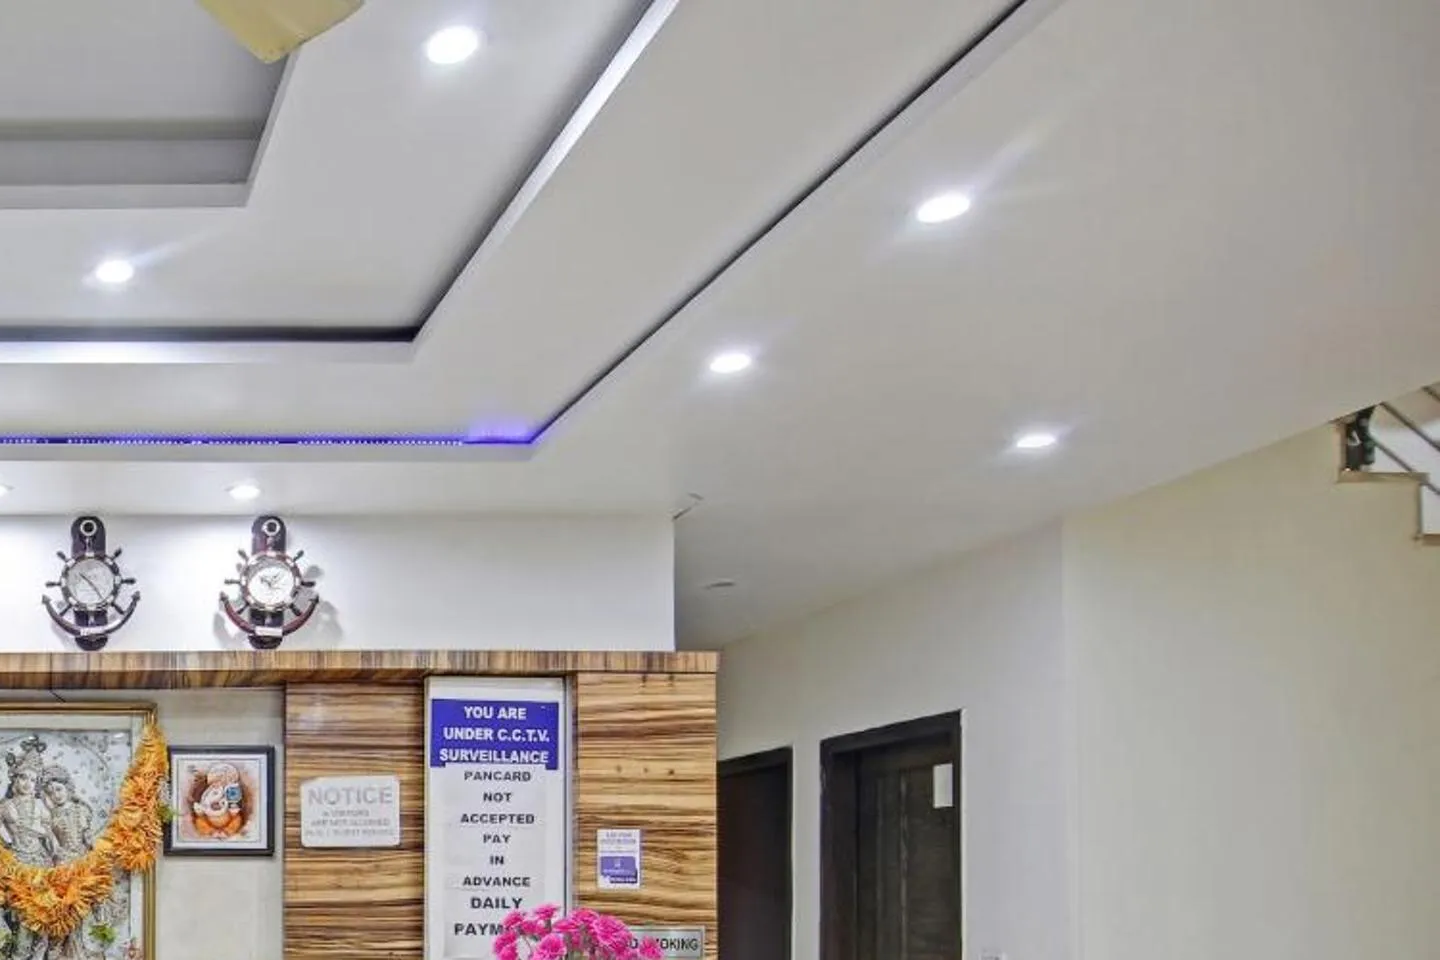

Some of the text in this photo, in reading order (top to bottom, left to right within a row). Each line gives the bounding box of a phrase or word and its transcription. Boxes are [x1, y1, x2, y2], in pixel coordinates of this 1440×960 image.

[464, 706, 527, 720] YOU ARE
[443, 728, 550, 742] UNDER C.C.T.V.
[439, 748, 550, 763] SURVEILLANCE
[464, 771, 531, 781] PANCARD
[308, 786, 393, 806] NOTICE
[483, 792, 512, 802] NOT
[460, 813, 535, 824] ACCEPTED
[483, 834, 511, 844] PAY
[489, 855, 504, 865] IN
[463, 876, 531, 887] ADVANCE
[470, 896, 523, 909] DAILY
[454, 923, 504, 936] PAYM
[656, 938, 699, 950] OKING
